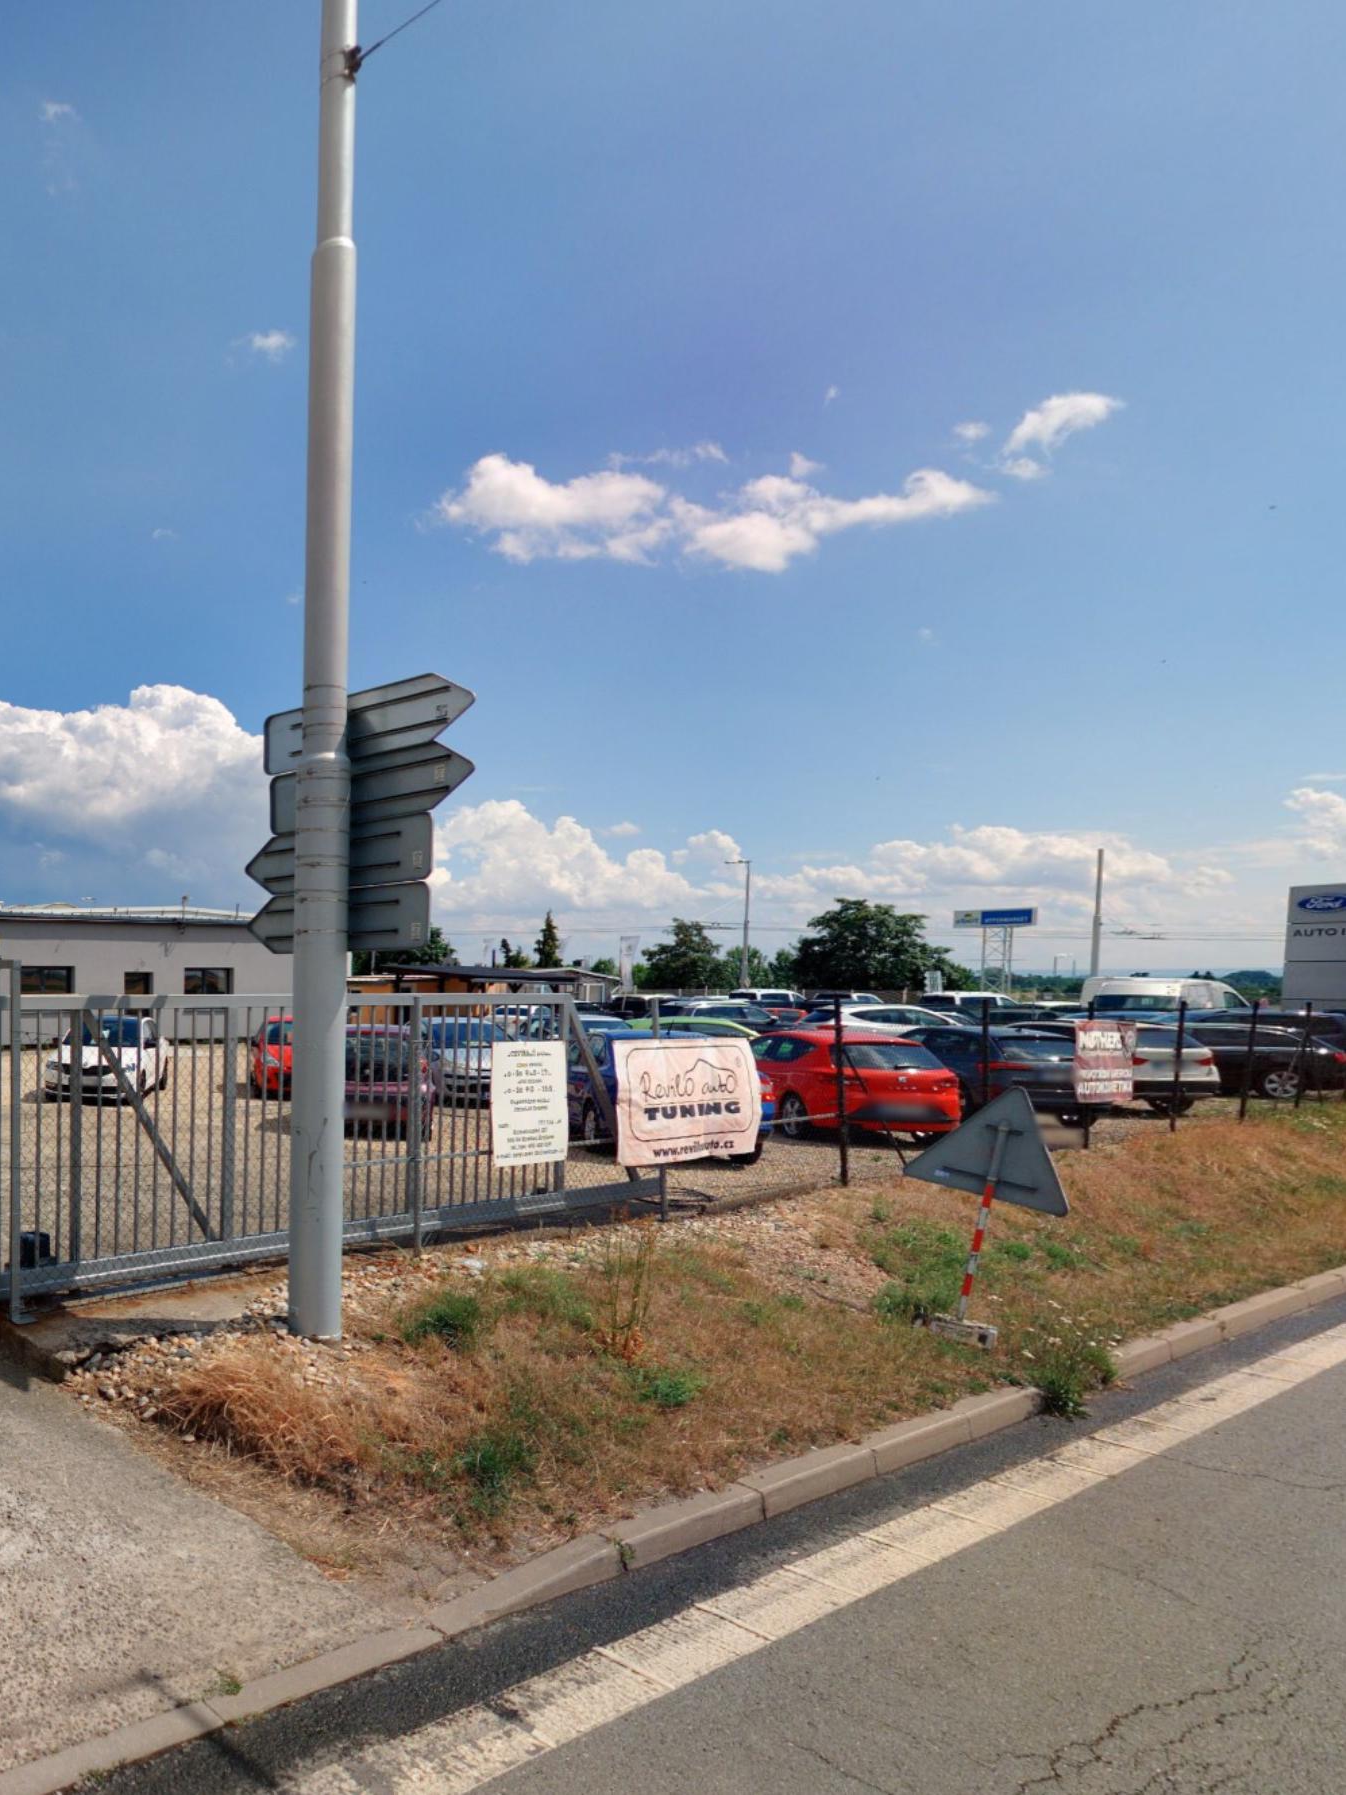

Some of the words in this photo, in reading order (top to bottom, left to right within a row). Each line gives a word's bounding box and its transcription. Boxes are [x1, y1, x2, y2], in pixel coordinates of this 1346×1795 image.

[1305, 896, 1344, 909] Ford
[1293, 927, 1337, 937] AUTO
[639, 1071, 695, 1102] Revilo
[644, 1101, 741, 1121] TUNING
